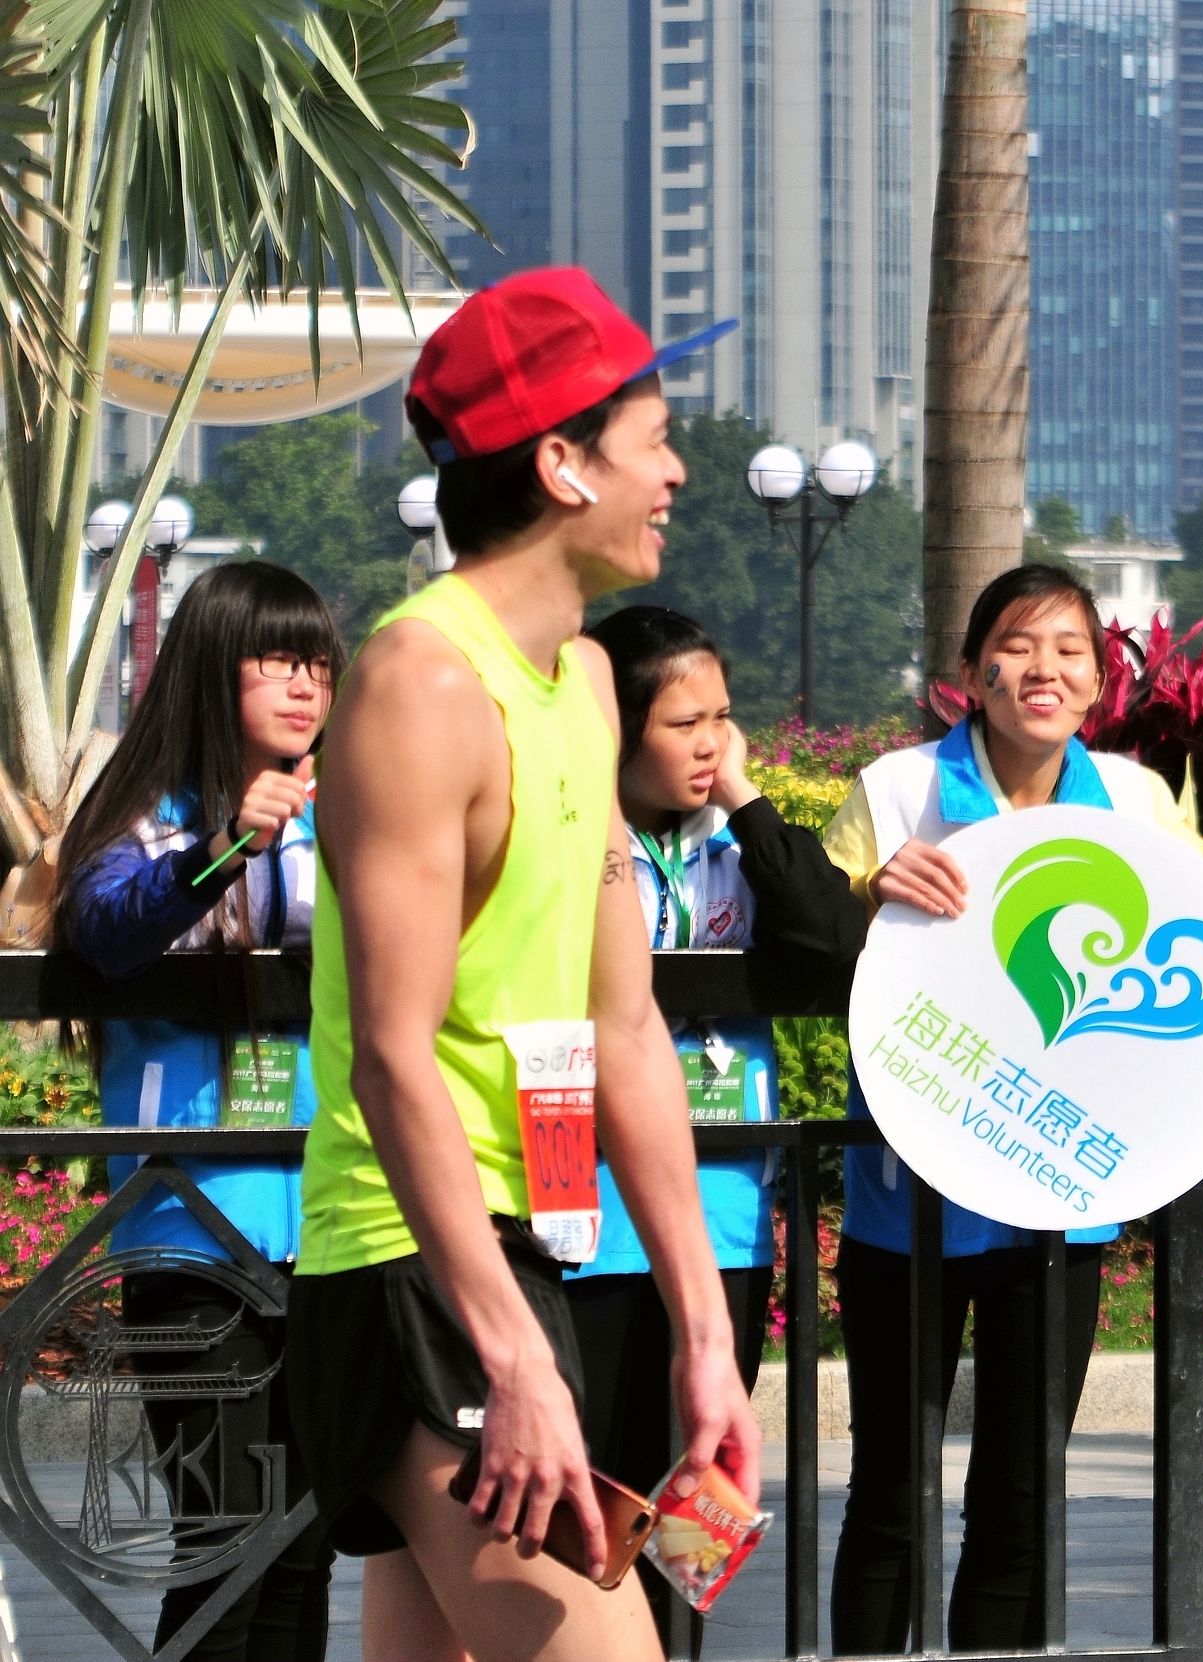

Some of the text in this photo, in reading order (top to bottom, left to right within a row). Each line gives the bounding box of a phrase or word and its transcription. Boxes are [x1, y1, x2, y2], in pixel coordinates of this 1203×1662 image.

[868, 1035, 1095, 1213] Haizhu Volunteers
[893, 991, 1129, 1180] 海珠志愿者
